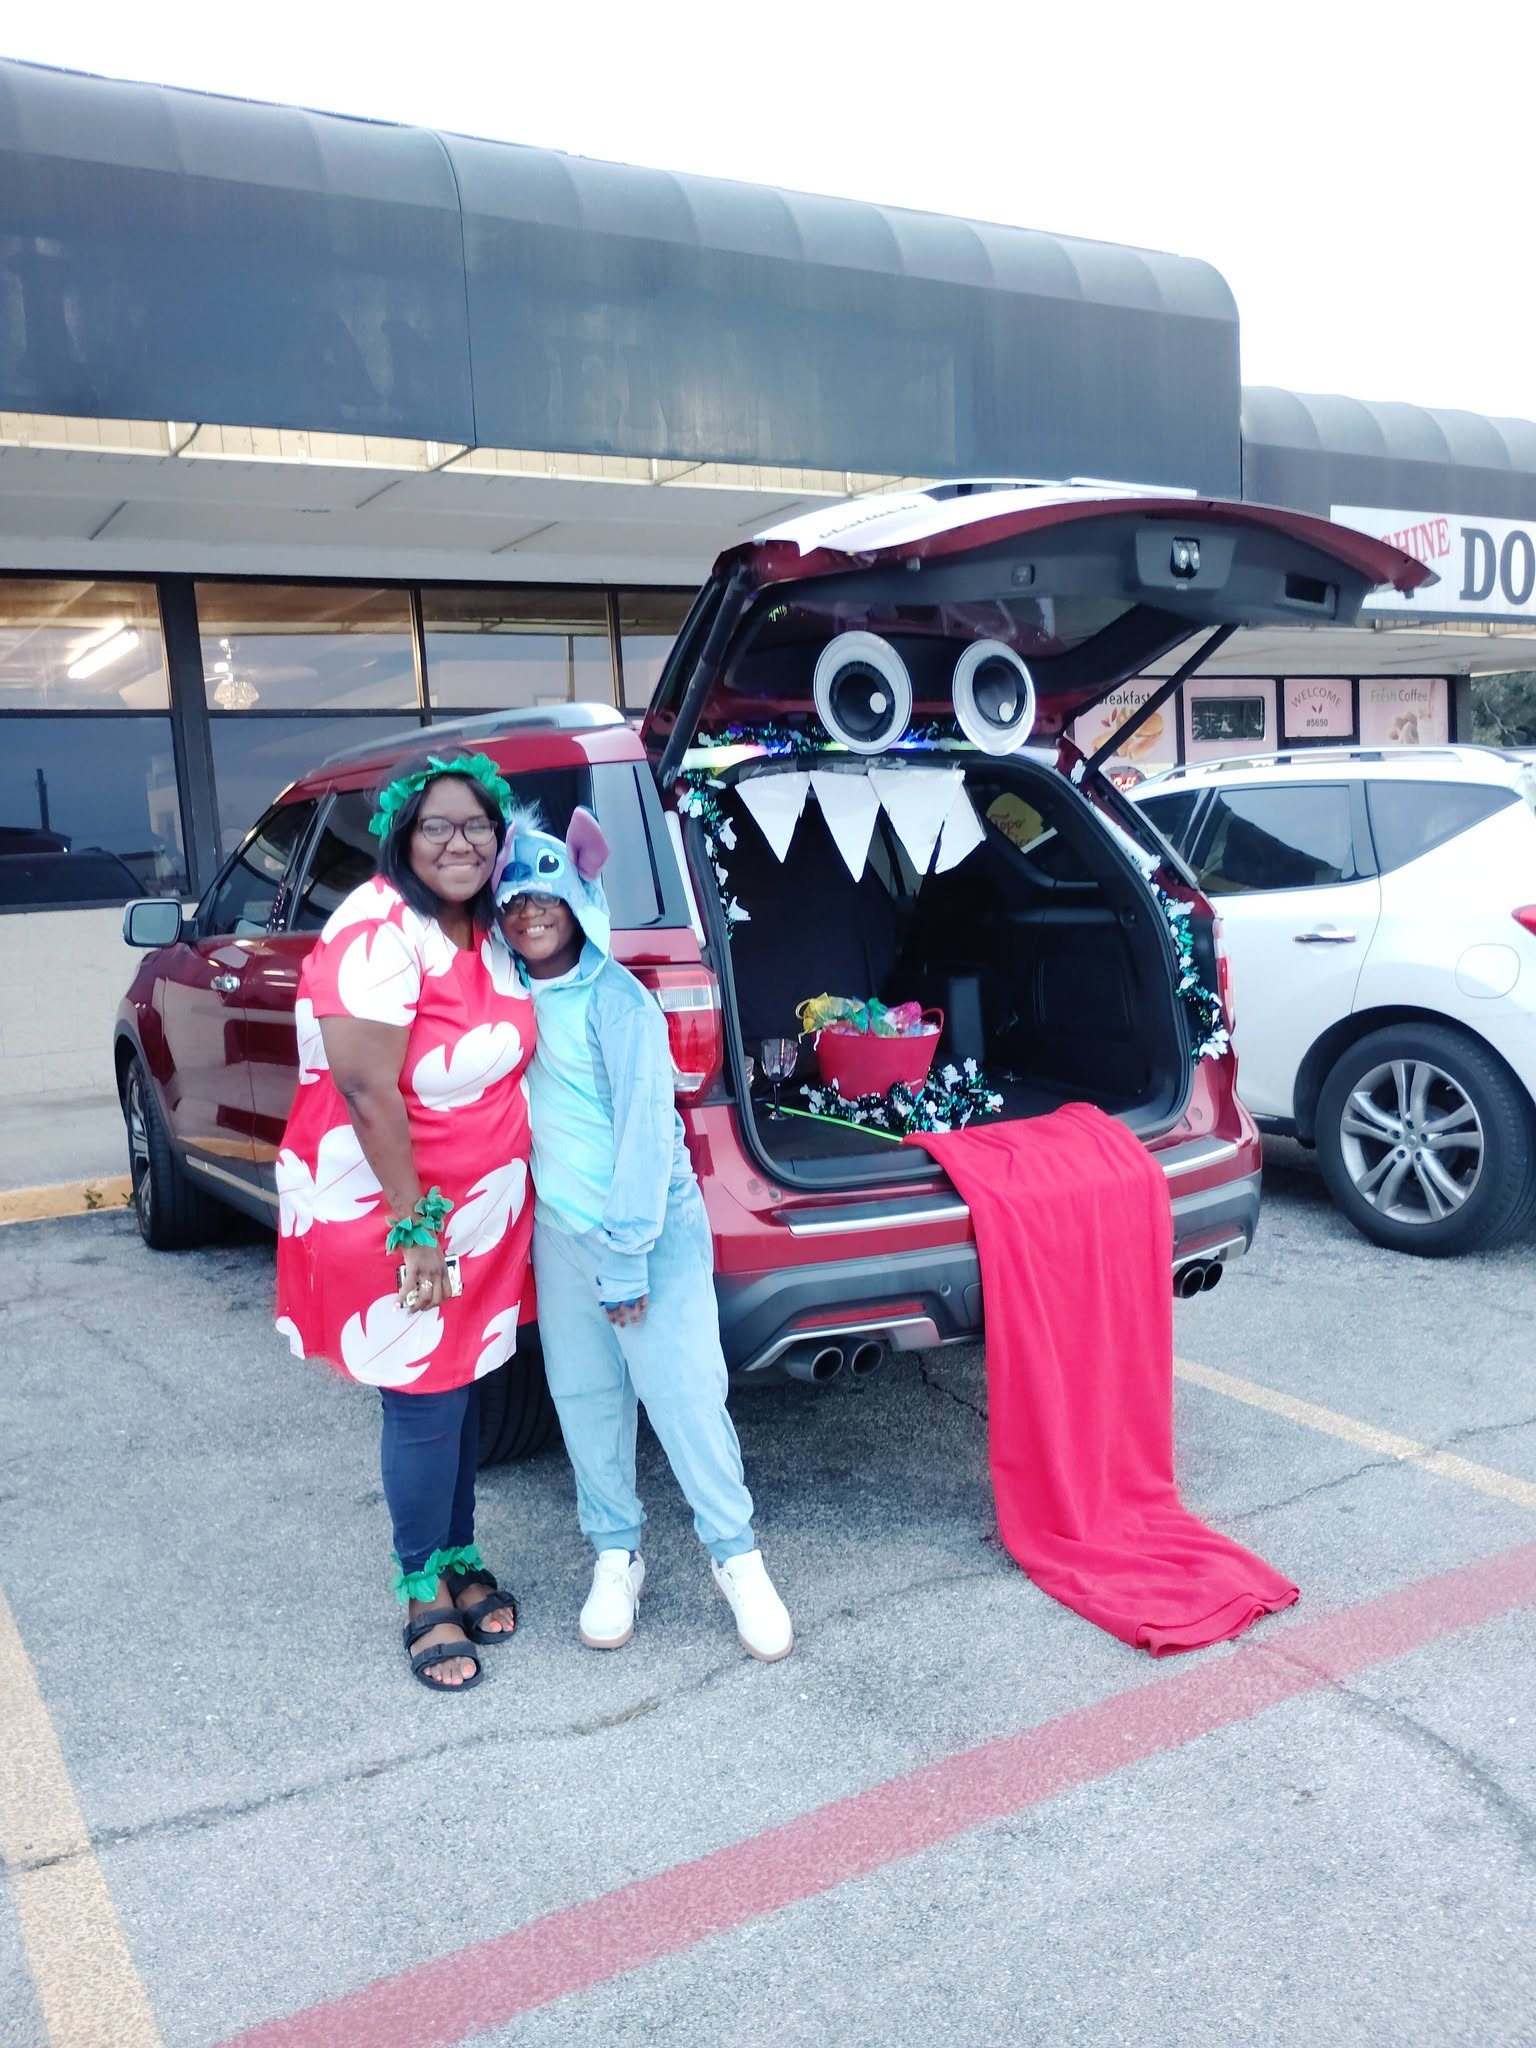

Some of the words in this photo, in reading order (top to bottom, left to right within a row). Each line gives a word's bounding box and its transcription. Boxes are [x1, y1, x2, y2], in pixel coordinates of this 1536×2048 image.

[1101, 690, 1150, 705] reakfast
[1291, 687, 1342, 708] WELCOME
[1370, 688, 1397, 703] Fresh
[1398, 688, 1428, 703] Coffee
